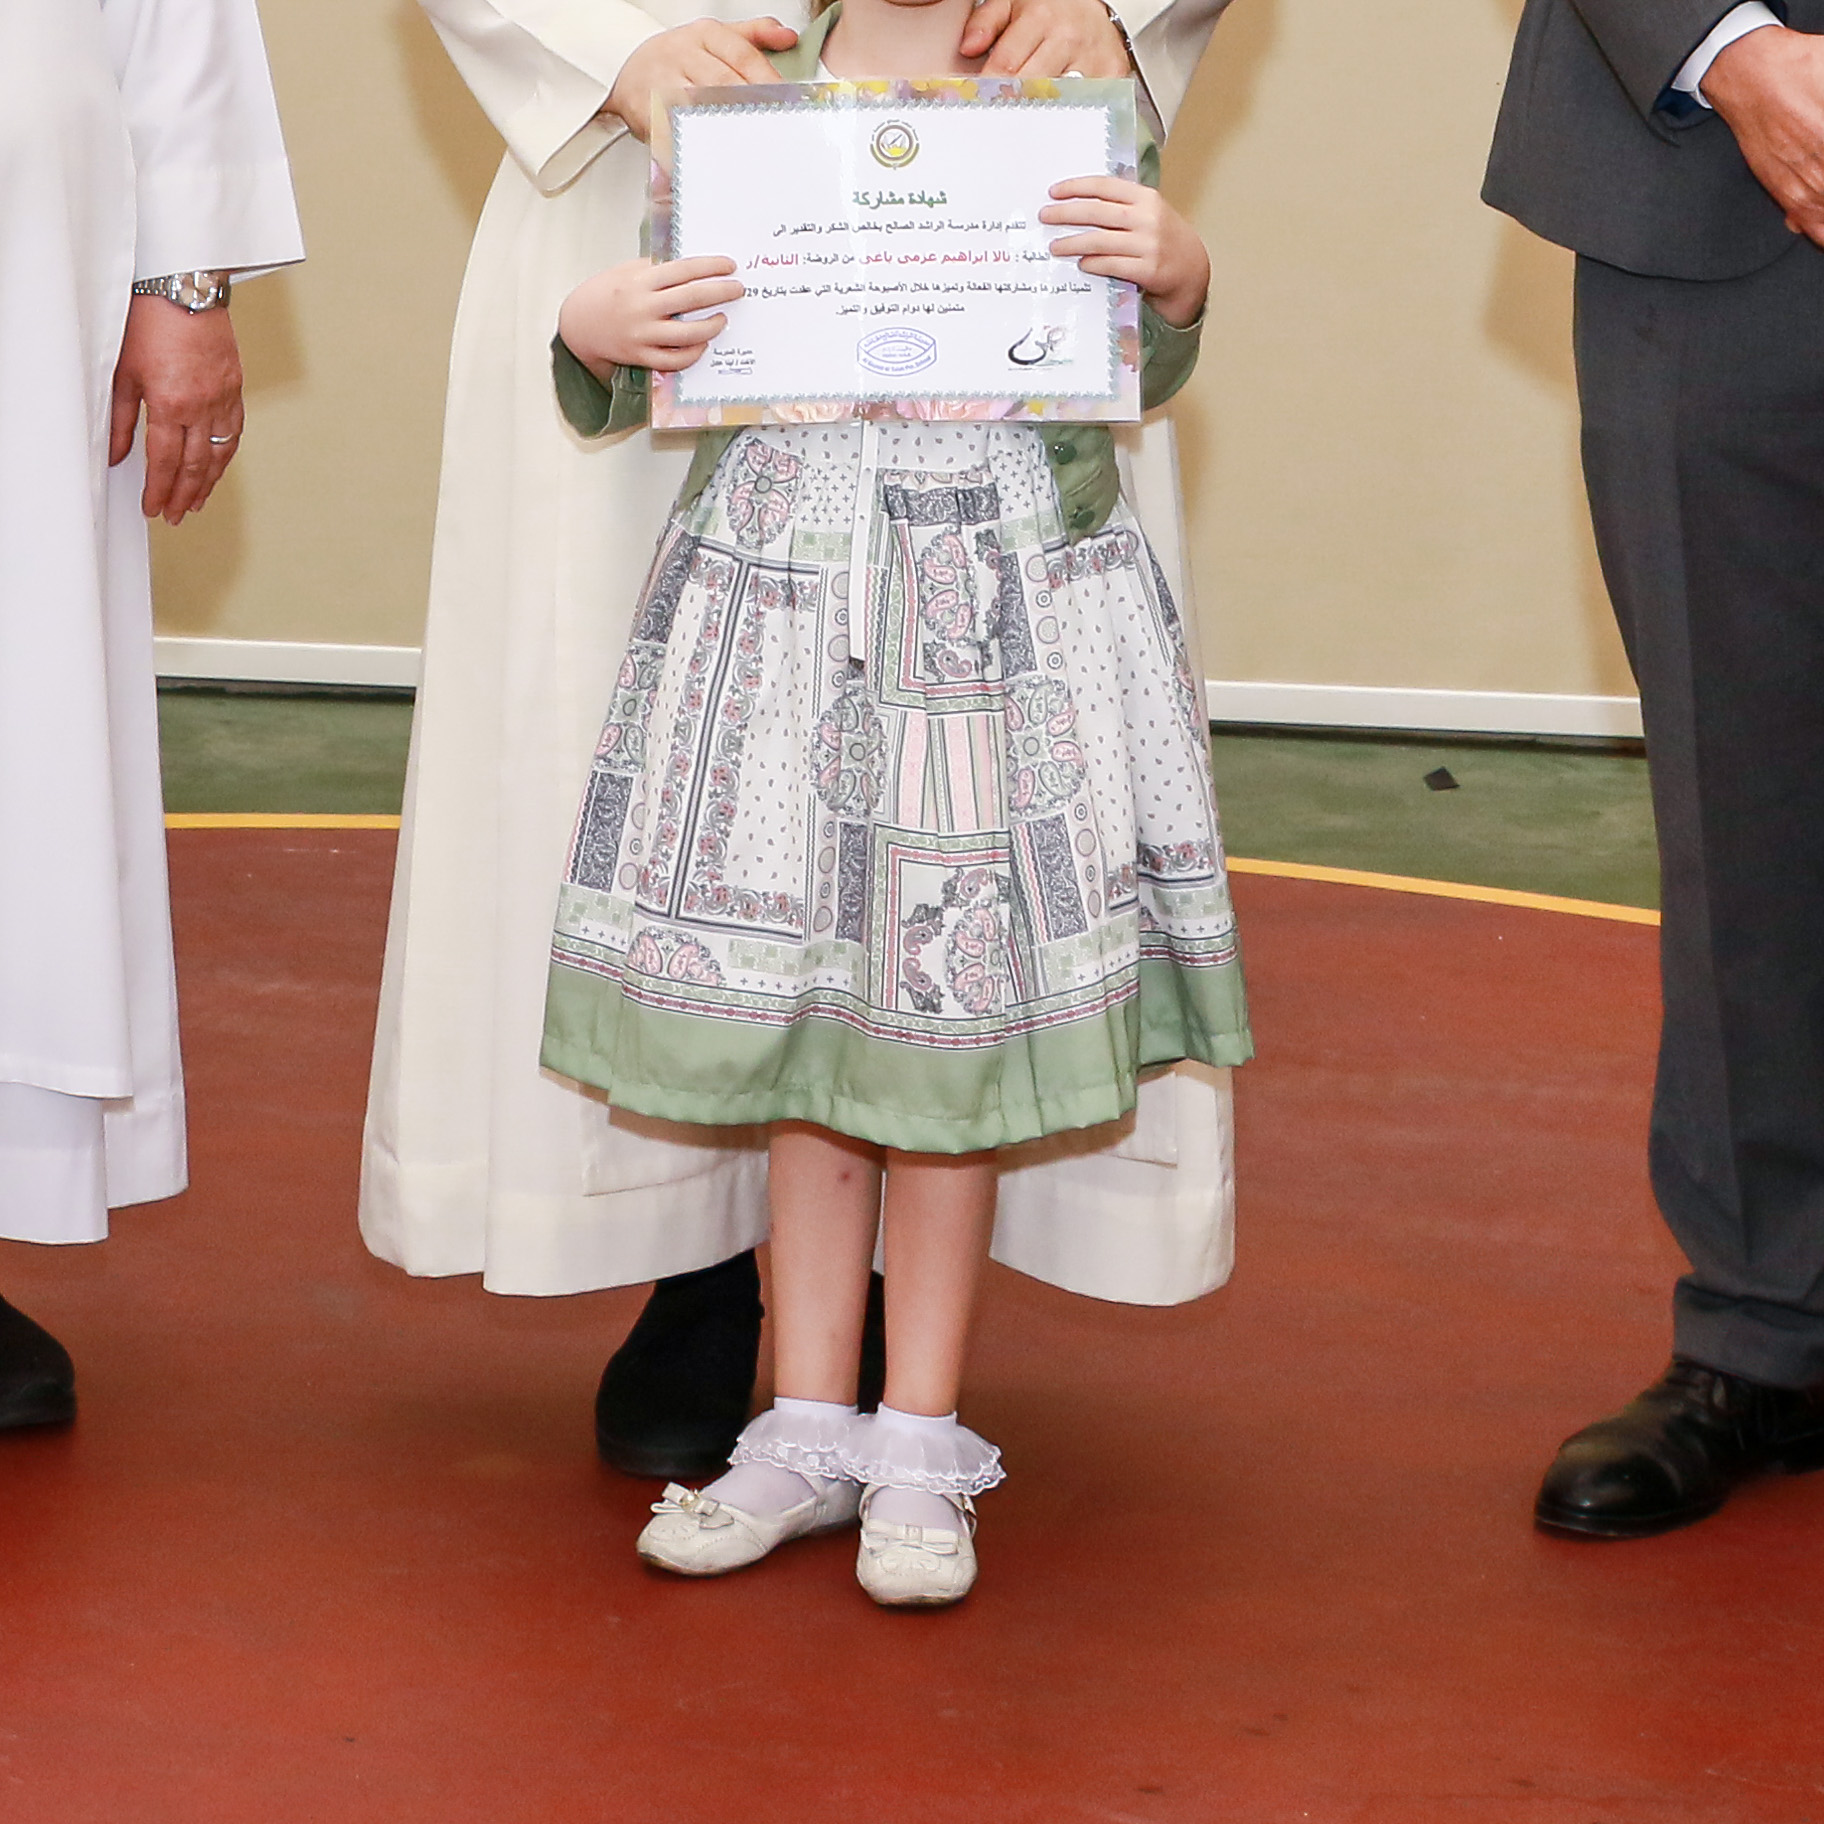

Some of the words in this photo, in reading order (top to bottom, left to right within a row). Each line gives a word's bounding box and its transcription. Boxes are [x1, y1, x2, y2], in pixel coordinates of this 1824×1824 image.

[852, 189, 906, 210] مشاركة
[908, 189, 948, 208] شهادة
[790, 222, 823, 235] والتقدير
[825, 221, 850, 234] الشكر
[885, 220, 915, 234] الصالح
[918, 219, 945, 232] الراشد
[947, 219, 979, 232] مدرسة
[982, 220, 1003, 232] إدارة
